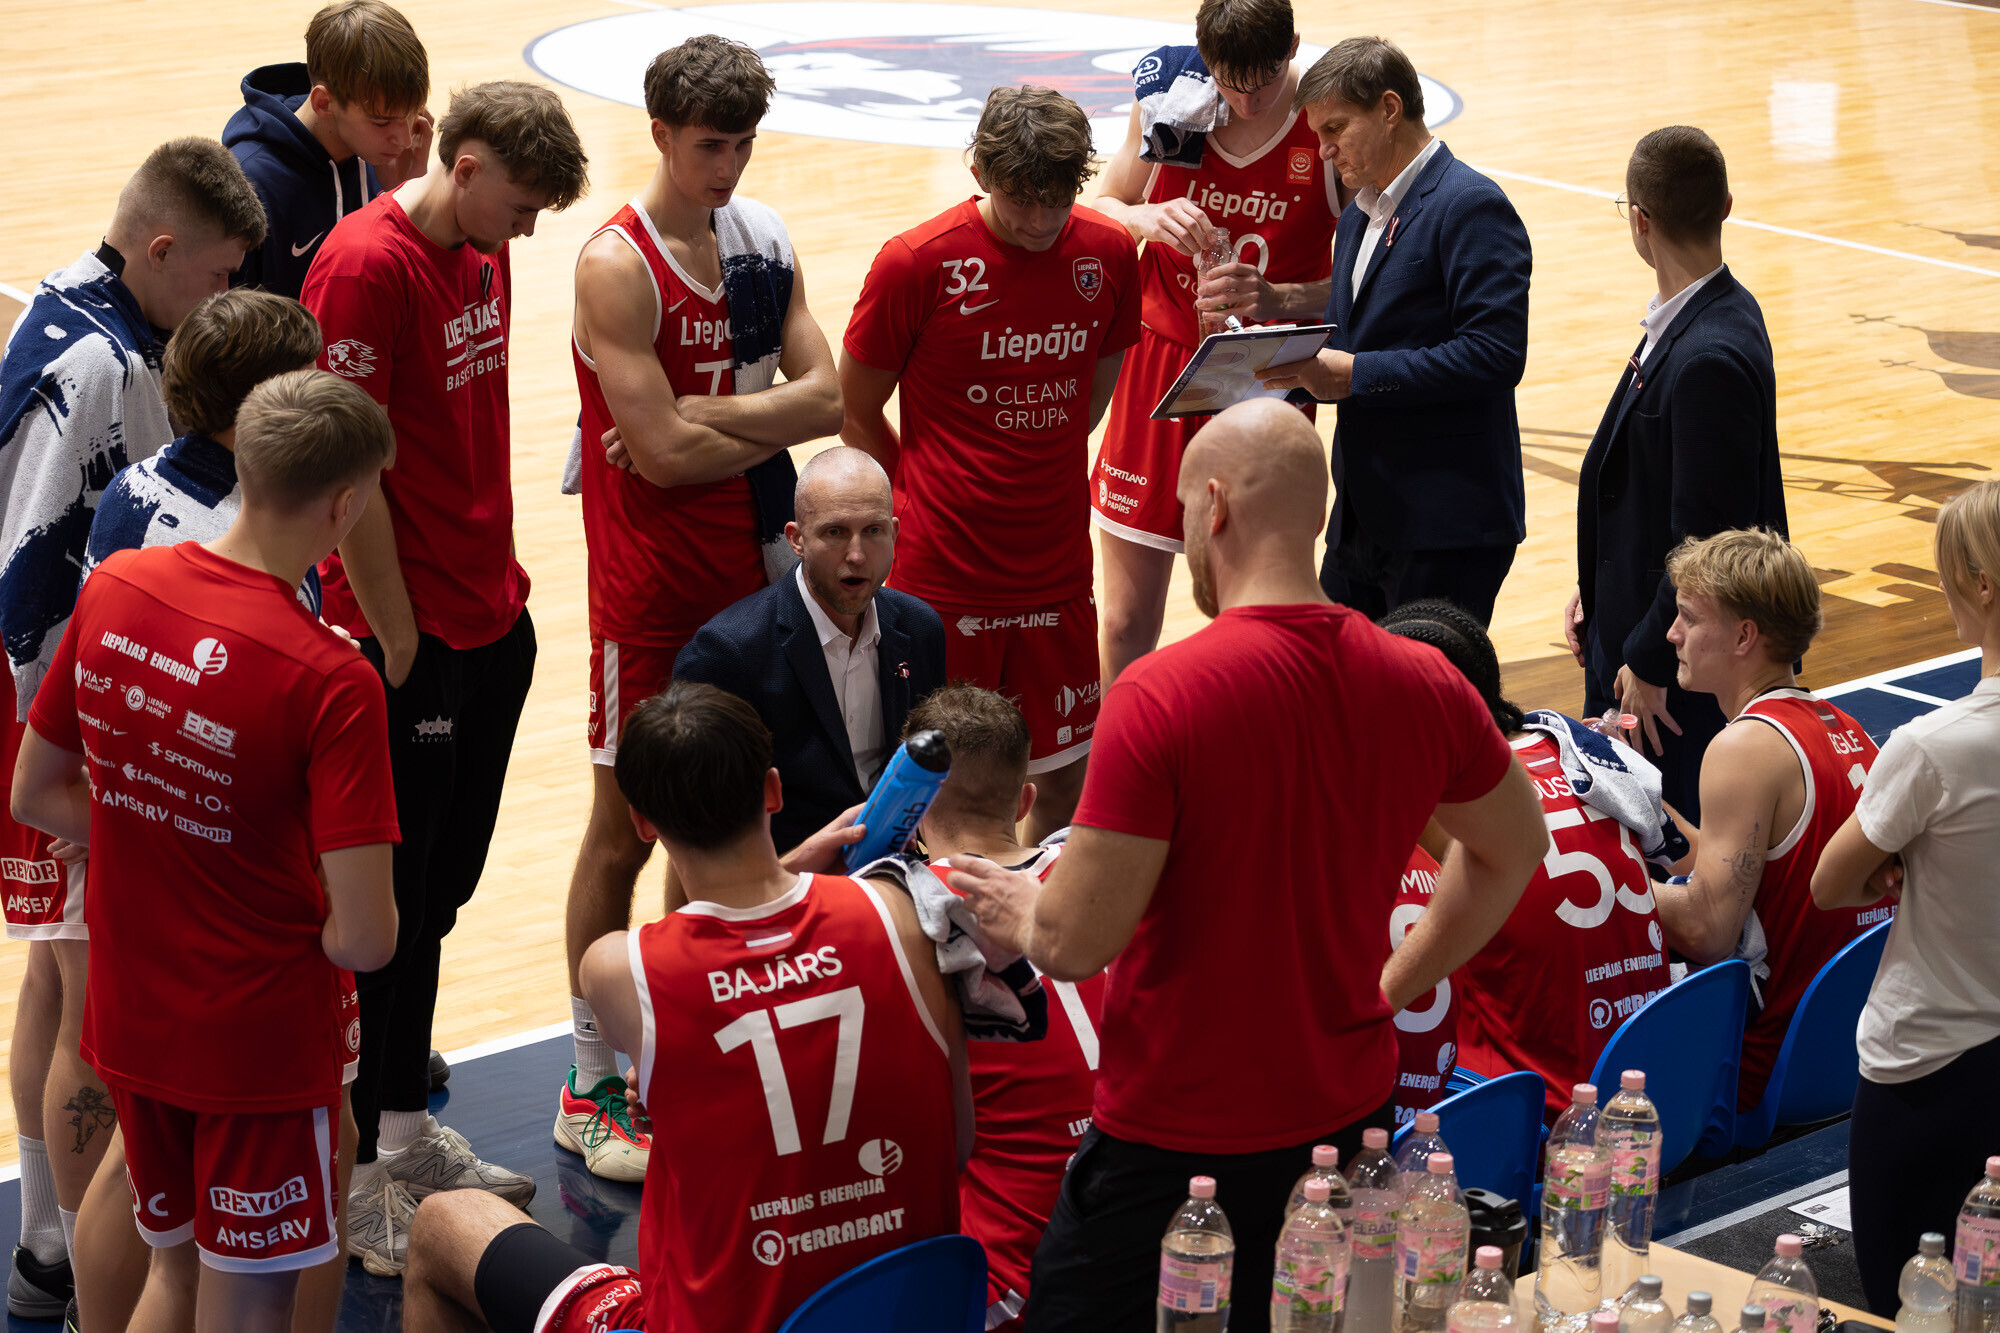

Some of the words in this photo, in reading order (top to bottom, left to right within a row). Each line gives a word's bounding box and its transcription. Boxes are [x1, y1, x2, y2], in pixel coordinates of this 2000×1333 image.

[1186, 180, 1288, 224] Liepāja
[942, 257, 989, 294] 32
[981, 322, 1088, 363] Liepāja
[995, 379, 1078, 405] CLEANR
[995, 406, 1069, 430] GRUPA
[1106, 500, 1131, 515] PAPĪRS
[1108, 491, 1139, 508] LIEPĀJAS
[984, 612, 1061, 631] LAPLINE
[100, 631, 148, 662] LIEPĀJAS
[150, 652, 201, 686] ENERĢIJA
[82, 668, 113, 690] VIA-S
[147, 696, 172, 713] LIEPĀJAS
[1827, 729, 1864, 755] EGLE
[164, 750, 232, 786] SPORTLAND
[137, 769, 187, 800] LAPLINE
[102, 790, 169, 822] AMSERV
[175, 815, 232, 842] REVOR
[2, 859, 58, 882] REVOR
[1857, 907, 1889, 926] LIEPĀJAS
[707, 946, 843, 1003] BAJĀRS
[1585, 960, 1623, 984] LIEPĀJAS
[713, 985, 866, 1157] 17
[211, 1179, 307, 1215] REVOR
[750, 1193, 815, 1221] LIEPĀJAS
[819, 1177, 886, 1202] ENERĢIJA
[216, 1218, 311, 1248] AMSERV
[787, 1208, 905, 1256] TERRABALT
[586, 1287, 622, 1324] HOUSES
